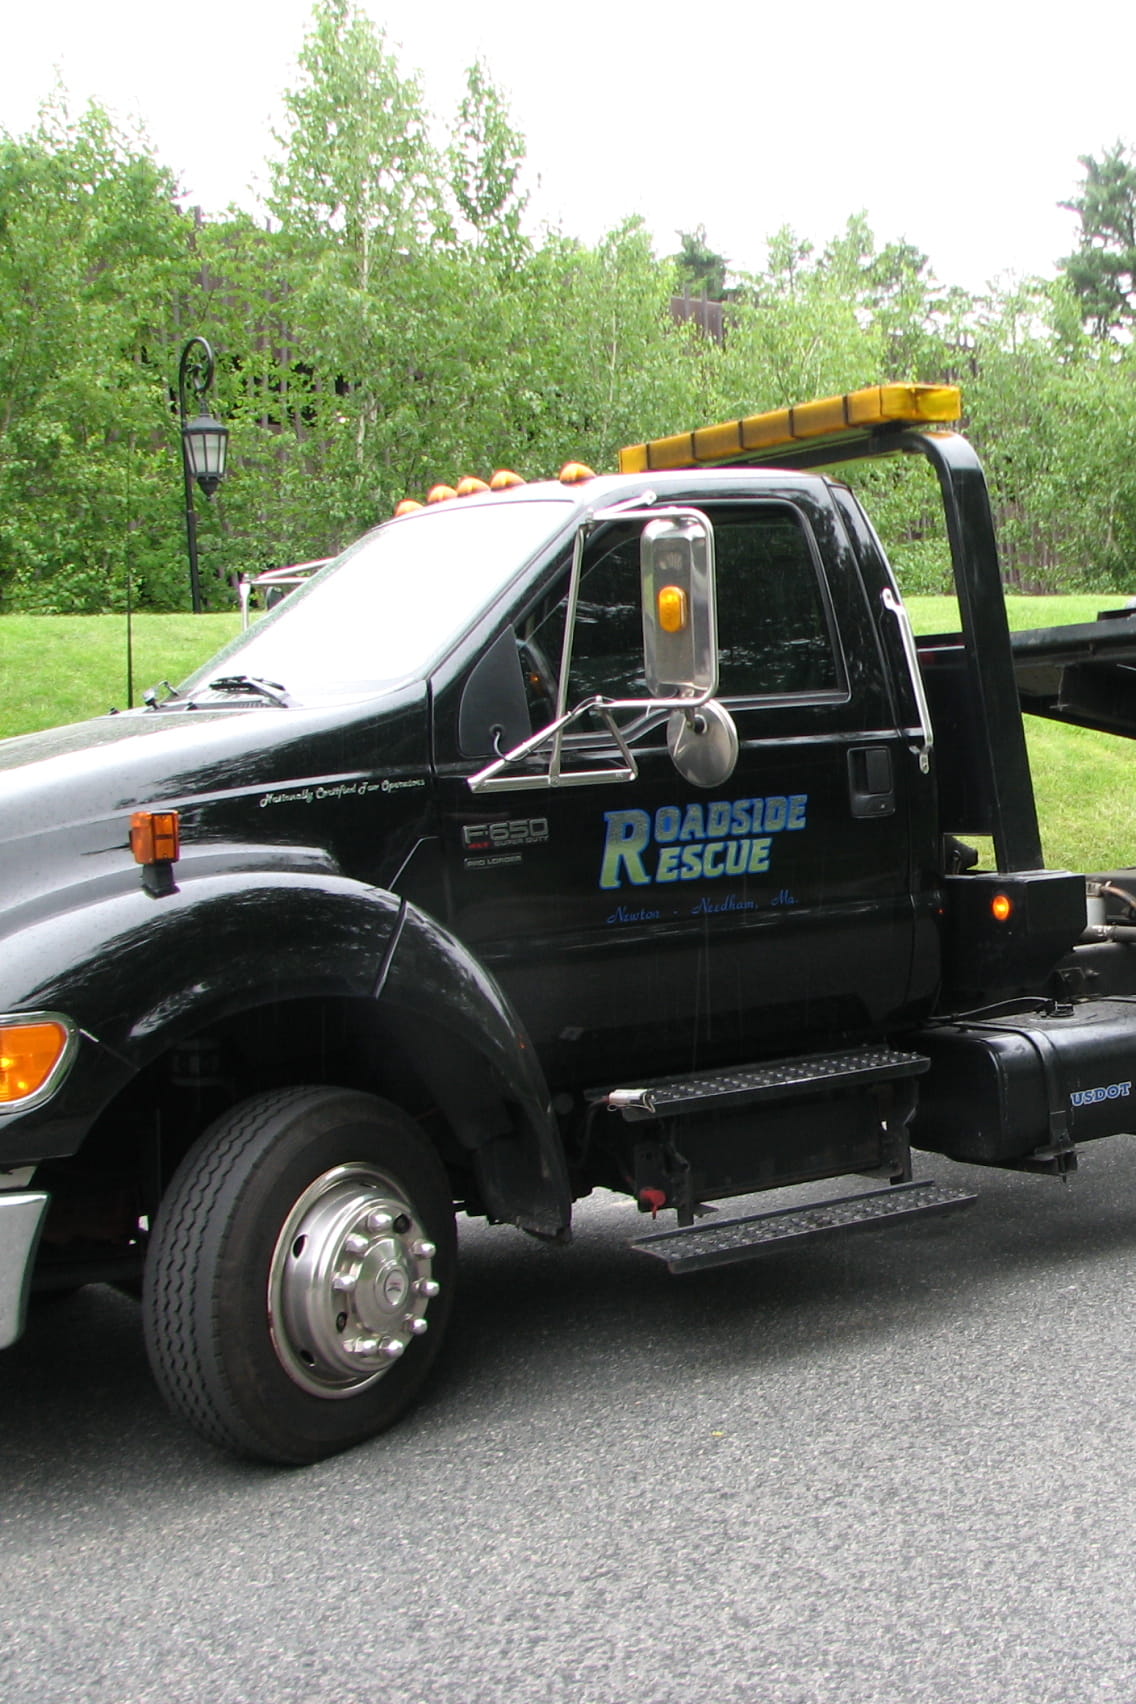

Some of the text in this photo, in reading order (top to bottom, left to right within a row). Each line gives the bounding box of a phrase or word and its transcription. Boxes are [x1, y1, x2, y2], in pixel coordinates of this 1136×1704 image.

[599, 794, 808, 889] ROADSIDE
[606, 905, 661, 924] Newton
[1070, 1081, 1131, 1107] USDOT
